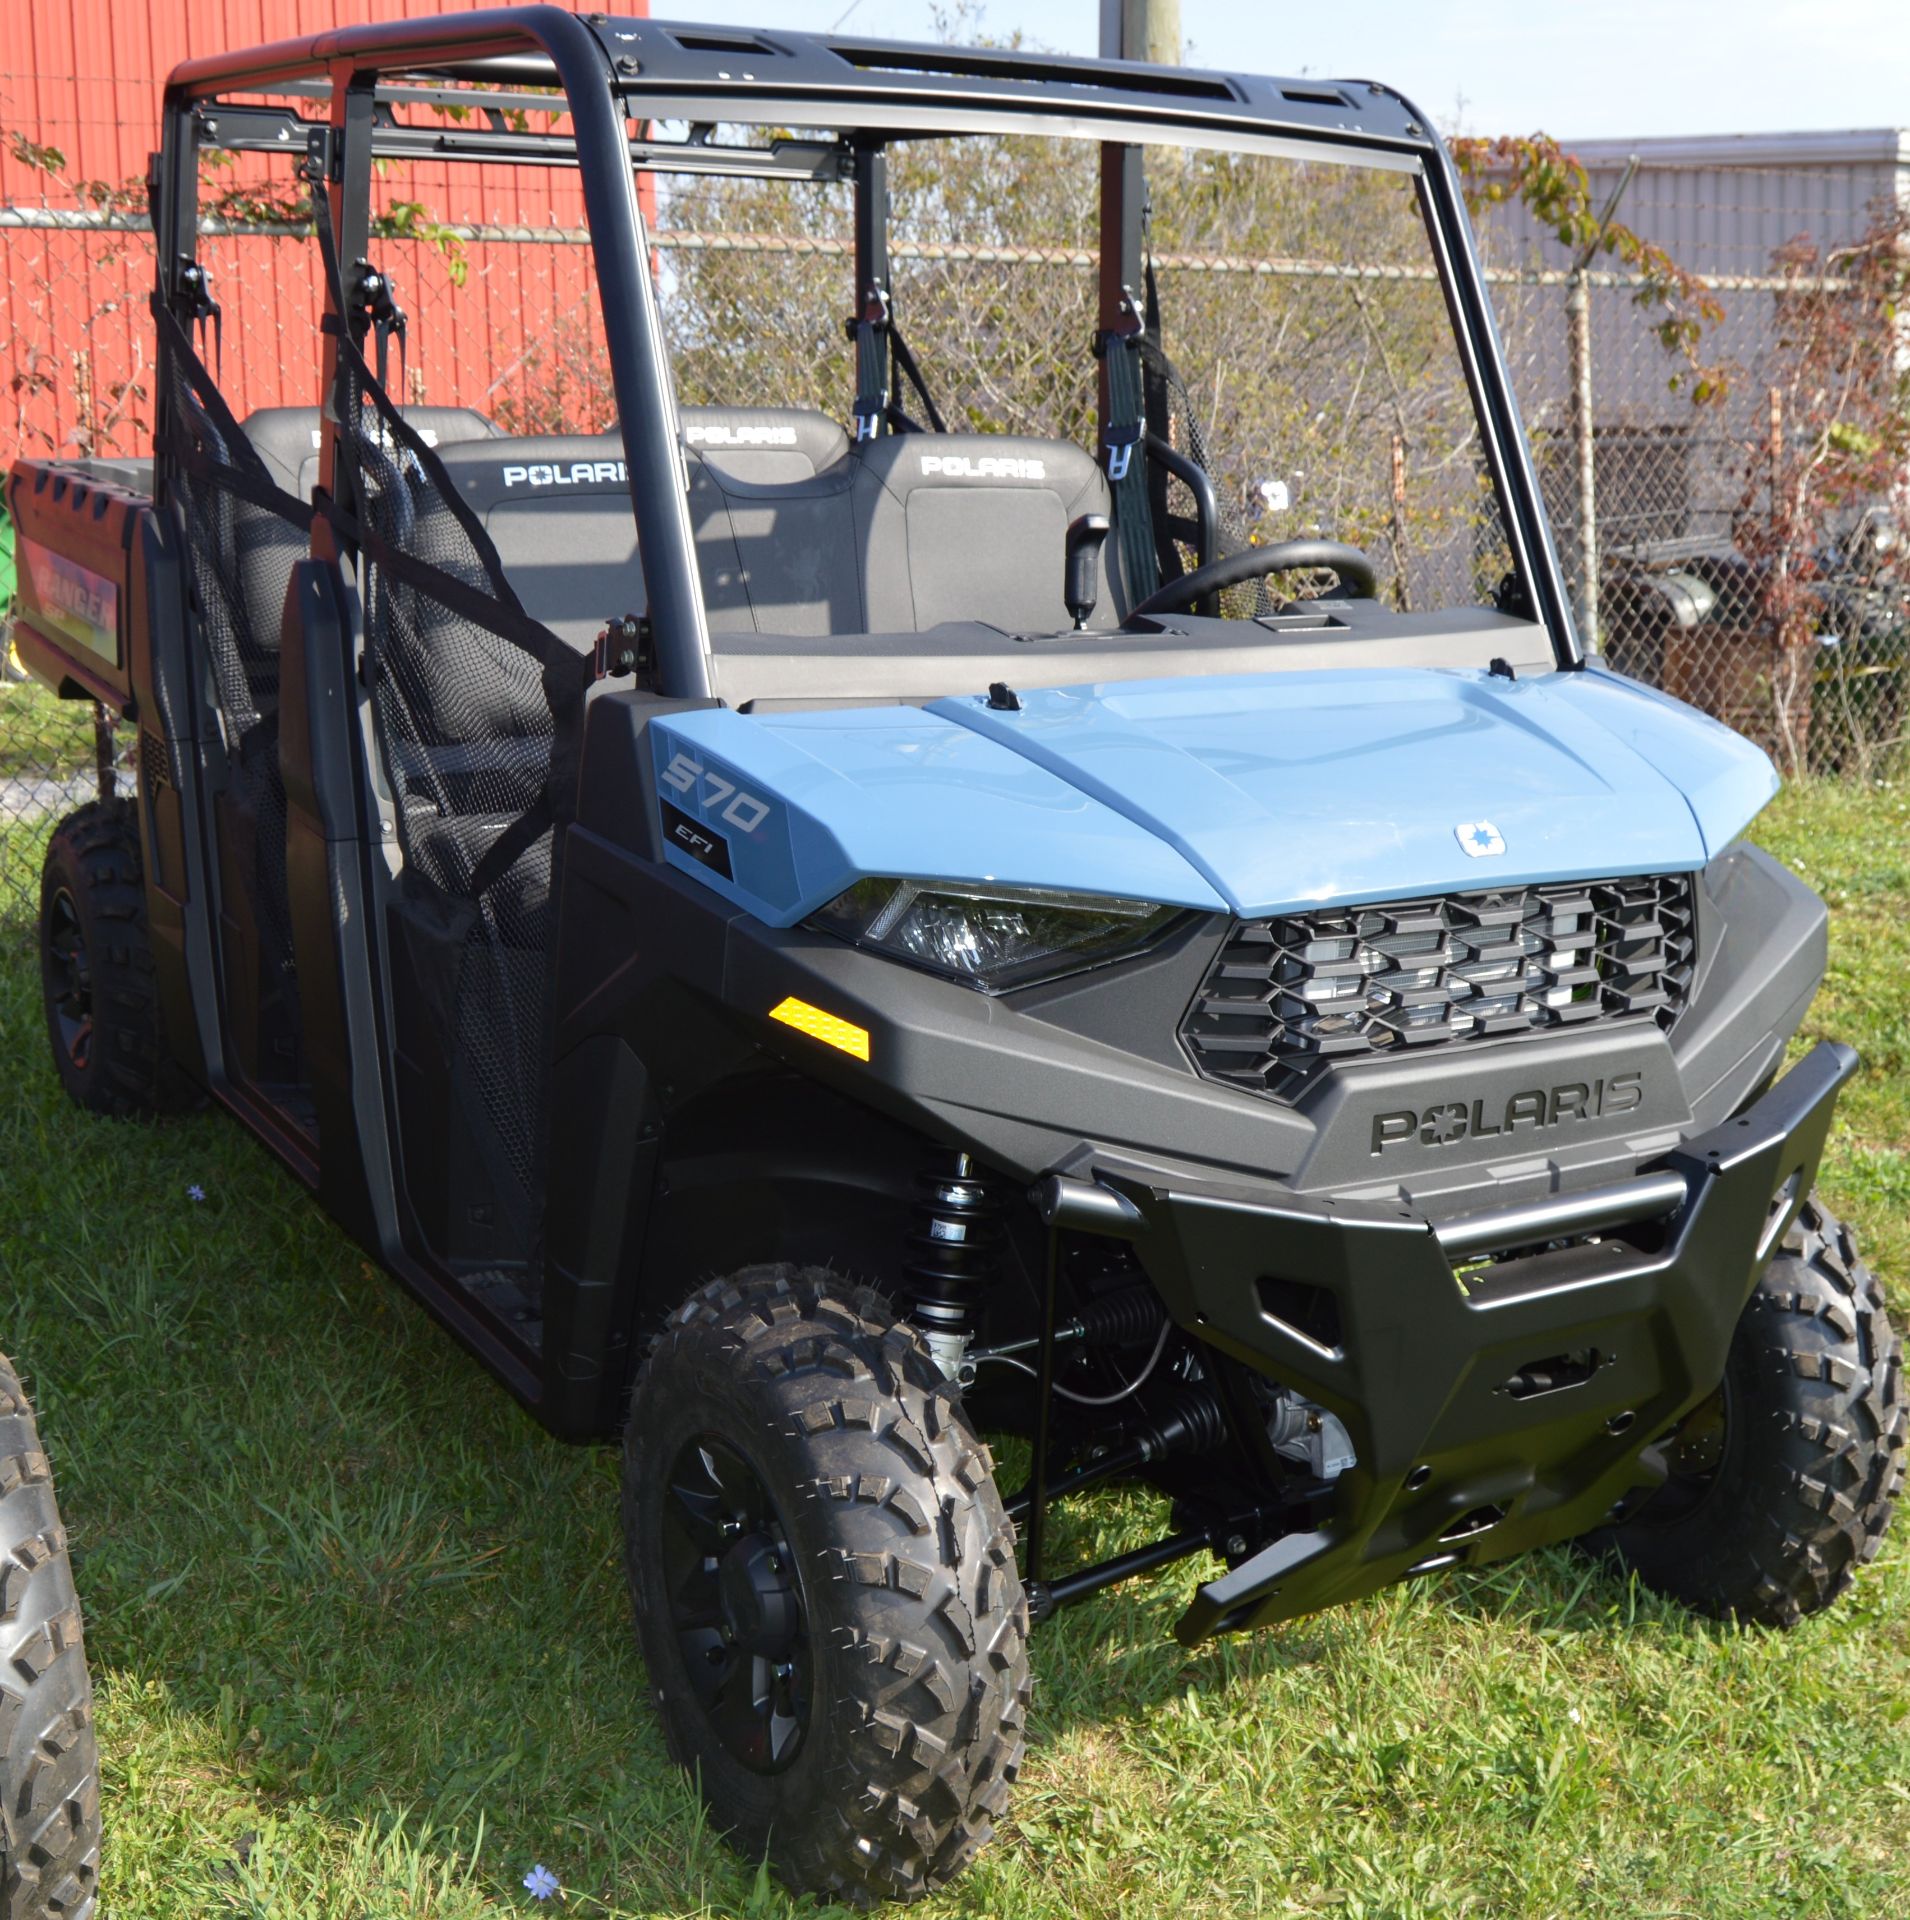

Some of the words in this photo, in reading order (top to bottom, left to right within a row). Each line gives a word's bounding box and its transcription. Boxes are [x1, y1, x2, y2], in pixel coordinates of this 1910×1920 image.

[686, 426, 797, 444] POLARIS
[503, 461, 629, 487] POLARI
[920, 456, 1045, 480] POLARIS
[661, 753, 770, 833] 570
[675, 824, 713, 853] EFI
[1370, 1071, 1643, 1158] POLARIS
